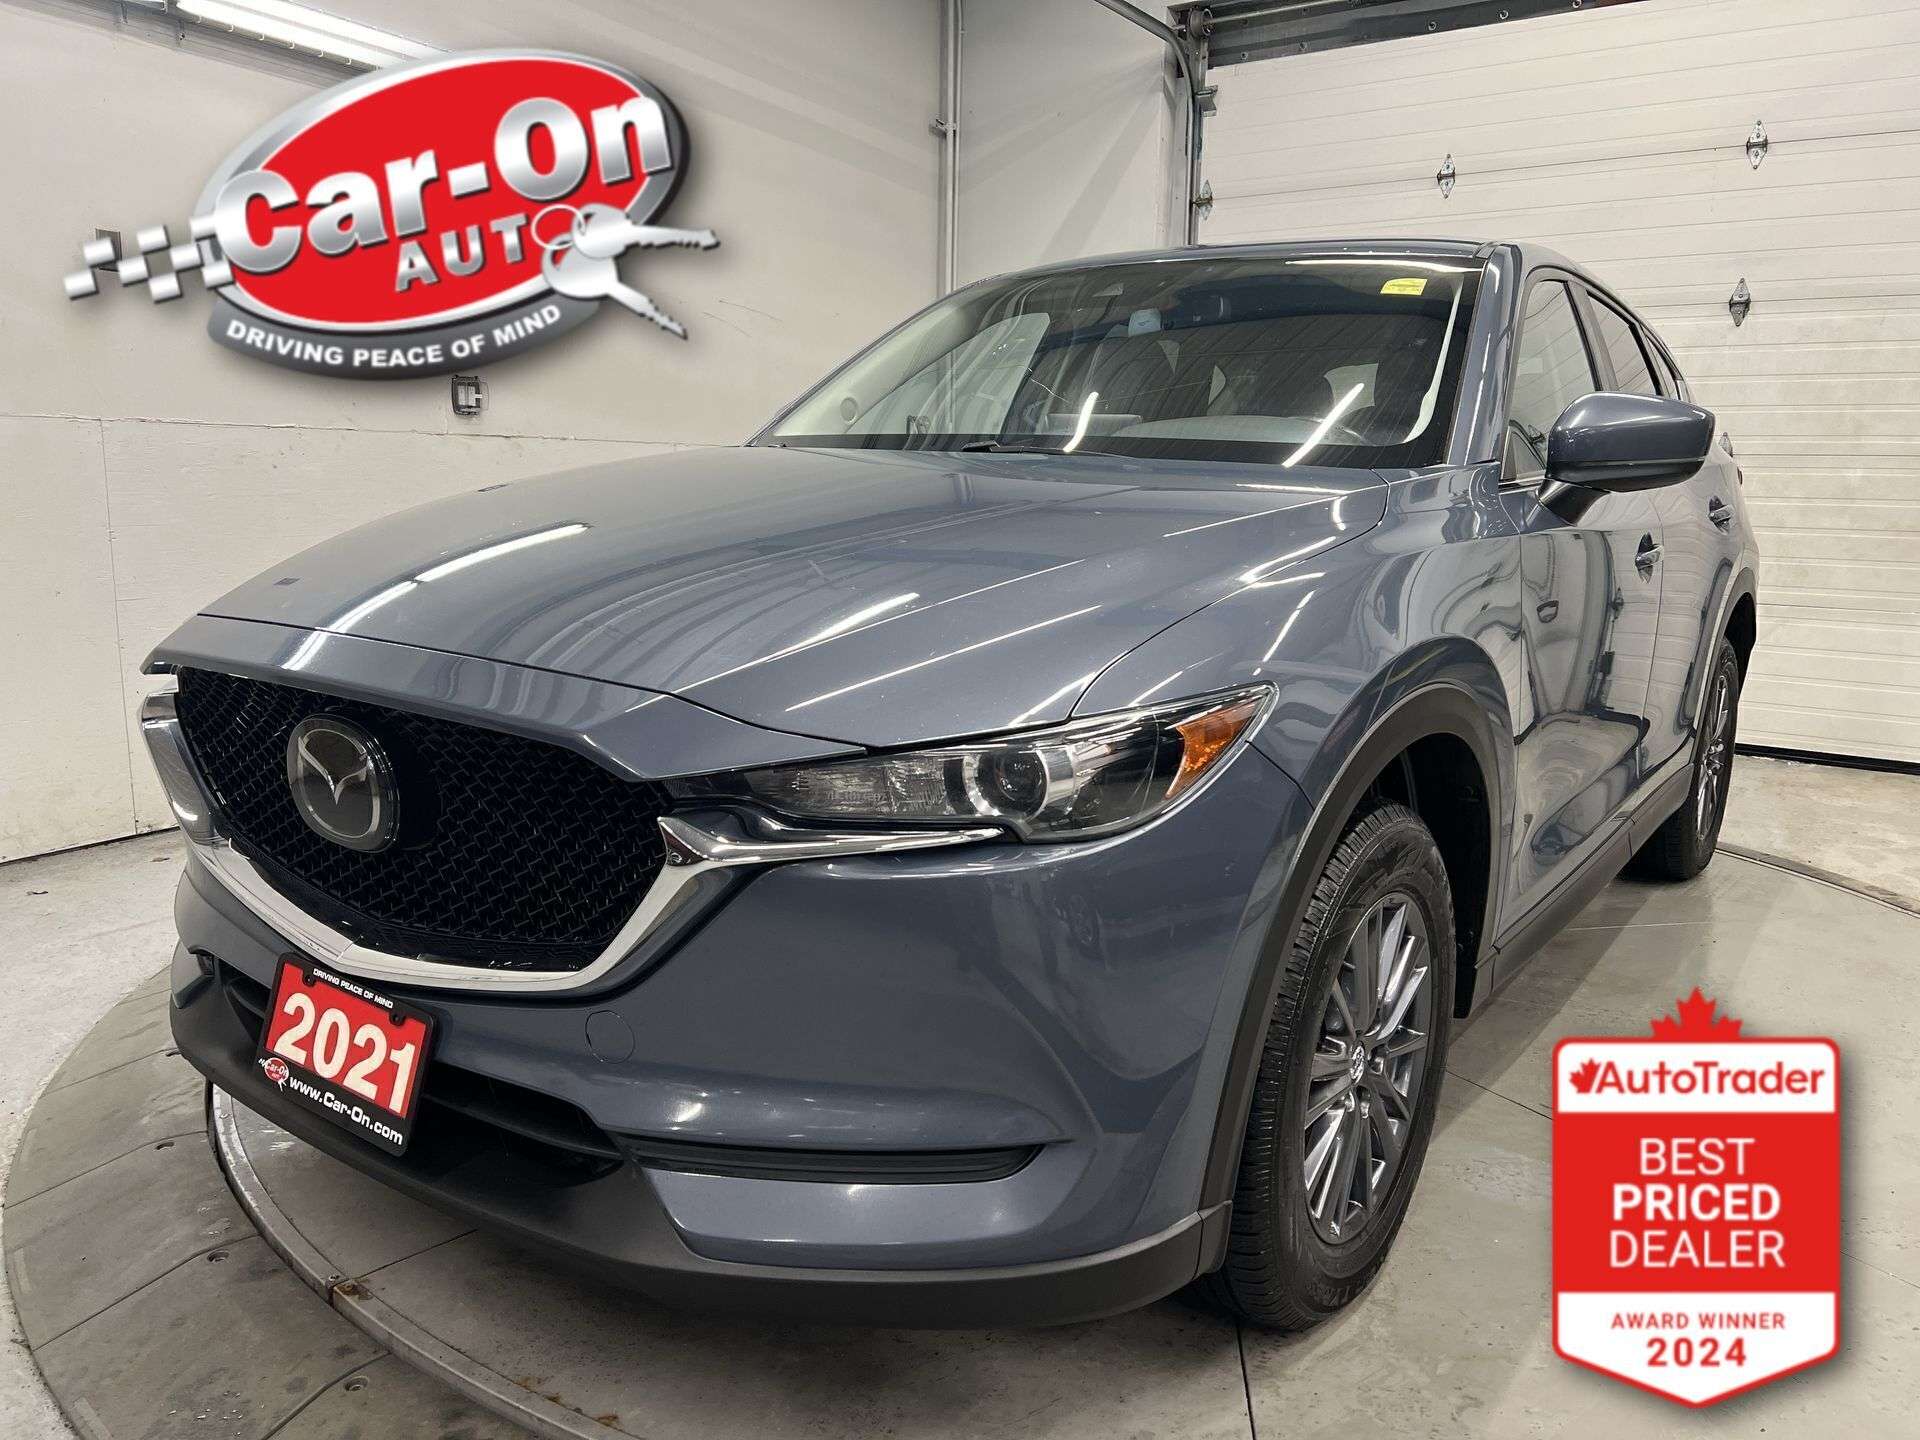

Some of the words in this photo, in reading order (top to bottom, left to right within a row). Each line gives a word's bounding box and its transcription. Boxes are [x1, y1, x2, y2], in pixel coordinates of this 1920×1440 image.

[313, 968, 340, 985] DRIVING
[340, 981, 363, 996] PEACE
[364, 990, 375, 1001] OF
[374, 996, 394, 1009] MIND
[273, 992, 416, 1114] 2021
[289, 1076, 404, 1146] www.Car-On.com
